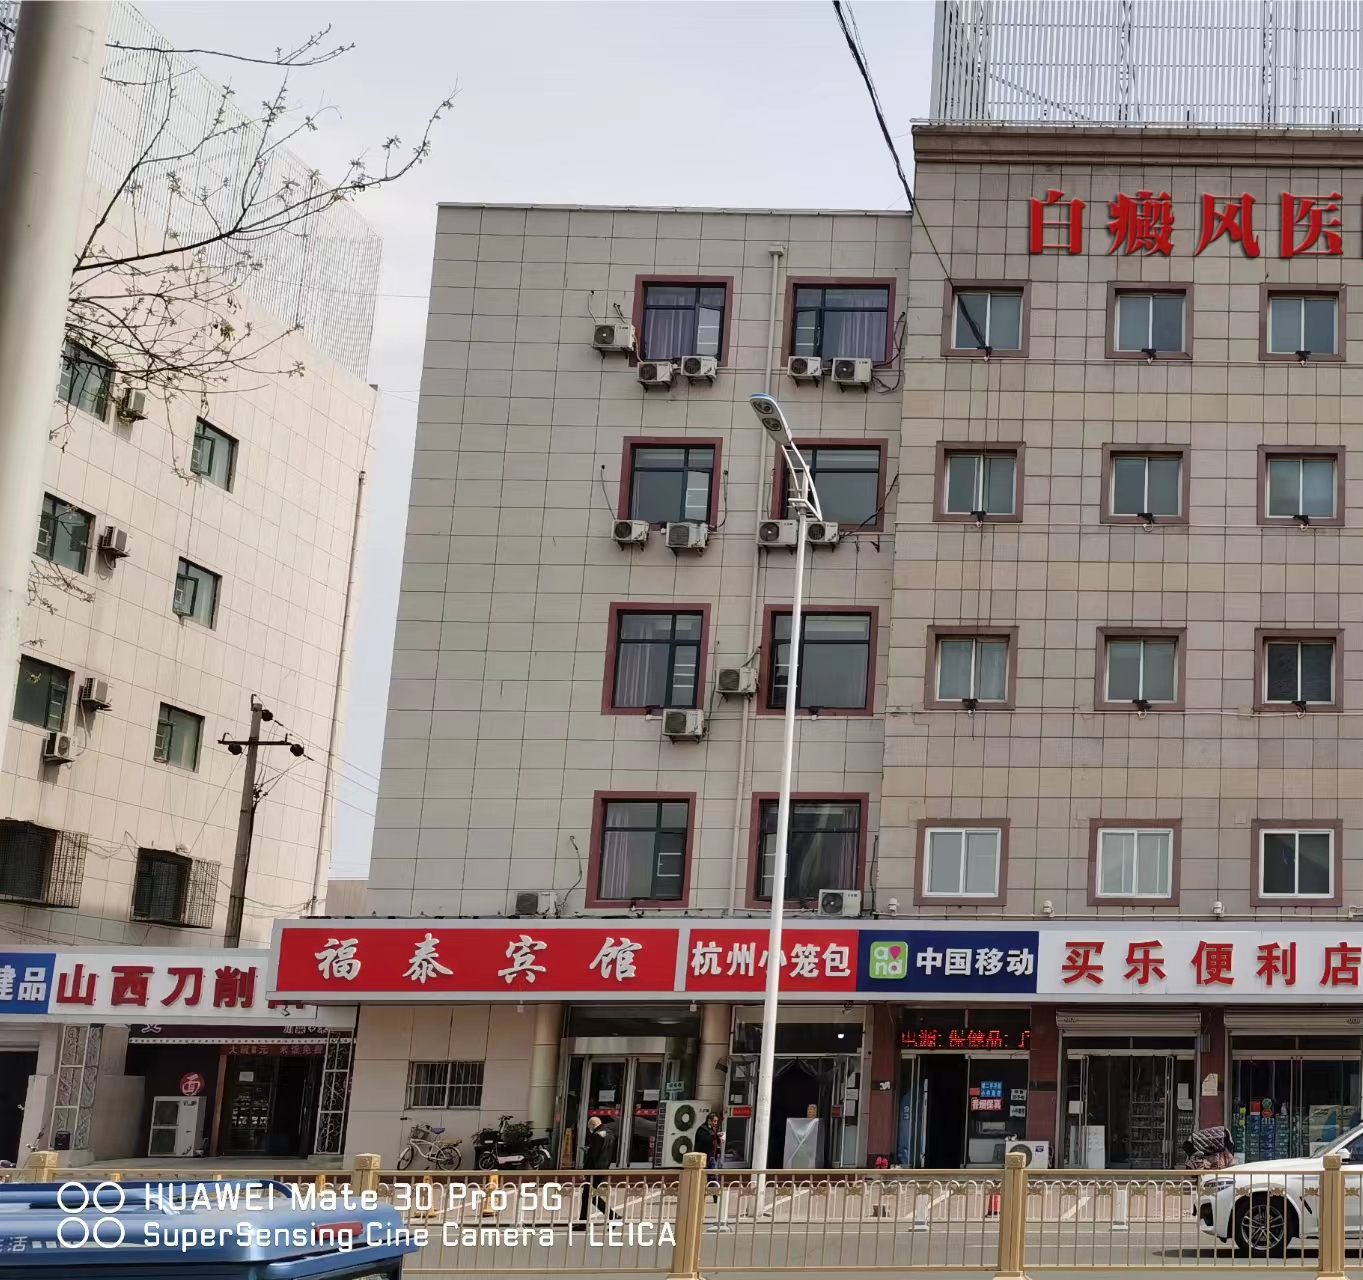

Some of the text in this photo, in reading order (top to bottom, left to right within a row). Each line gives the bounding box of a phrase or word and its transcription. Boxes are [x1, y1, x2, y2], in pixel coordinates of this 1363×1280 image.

[313, 932, 643, 985] 福泰宾馆
[916, 946, 1035, 977] 中国移动
[1061, 940, 1363, 987] 买乐便利店
[56, 963, 305, 1010] 山西刀削
